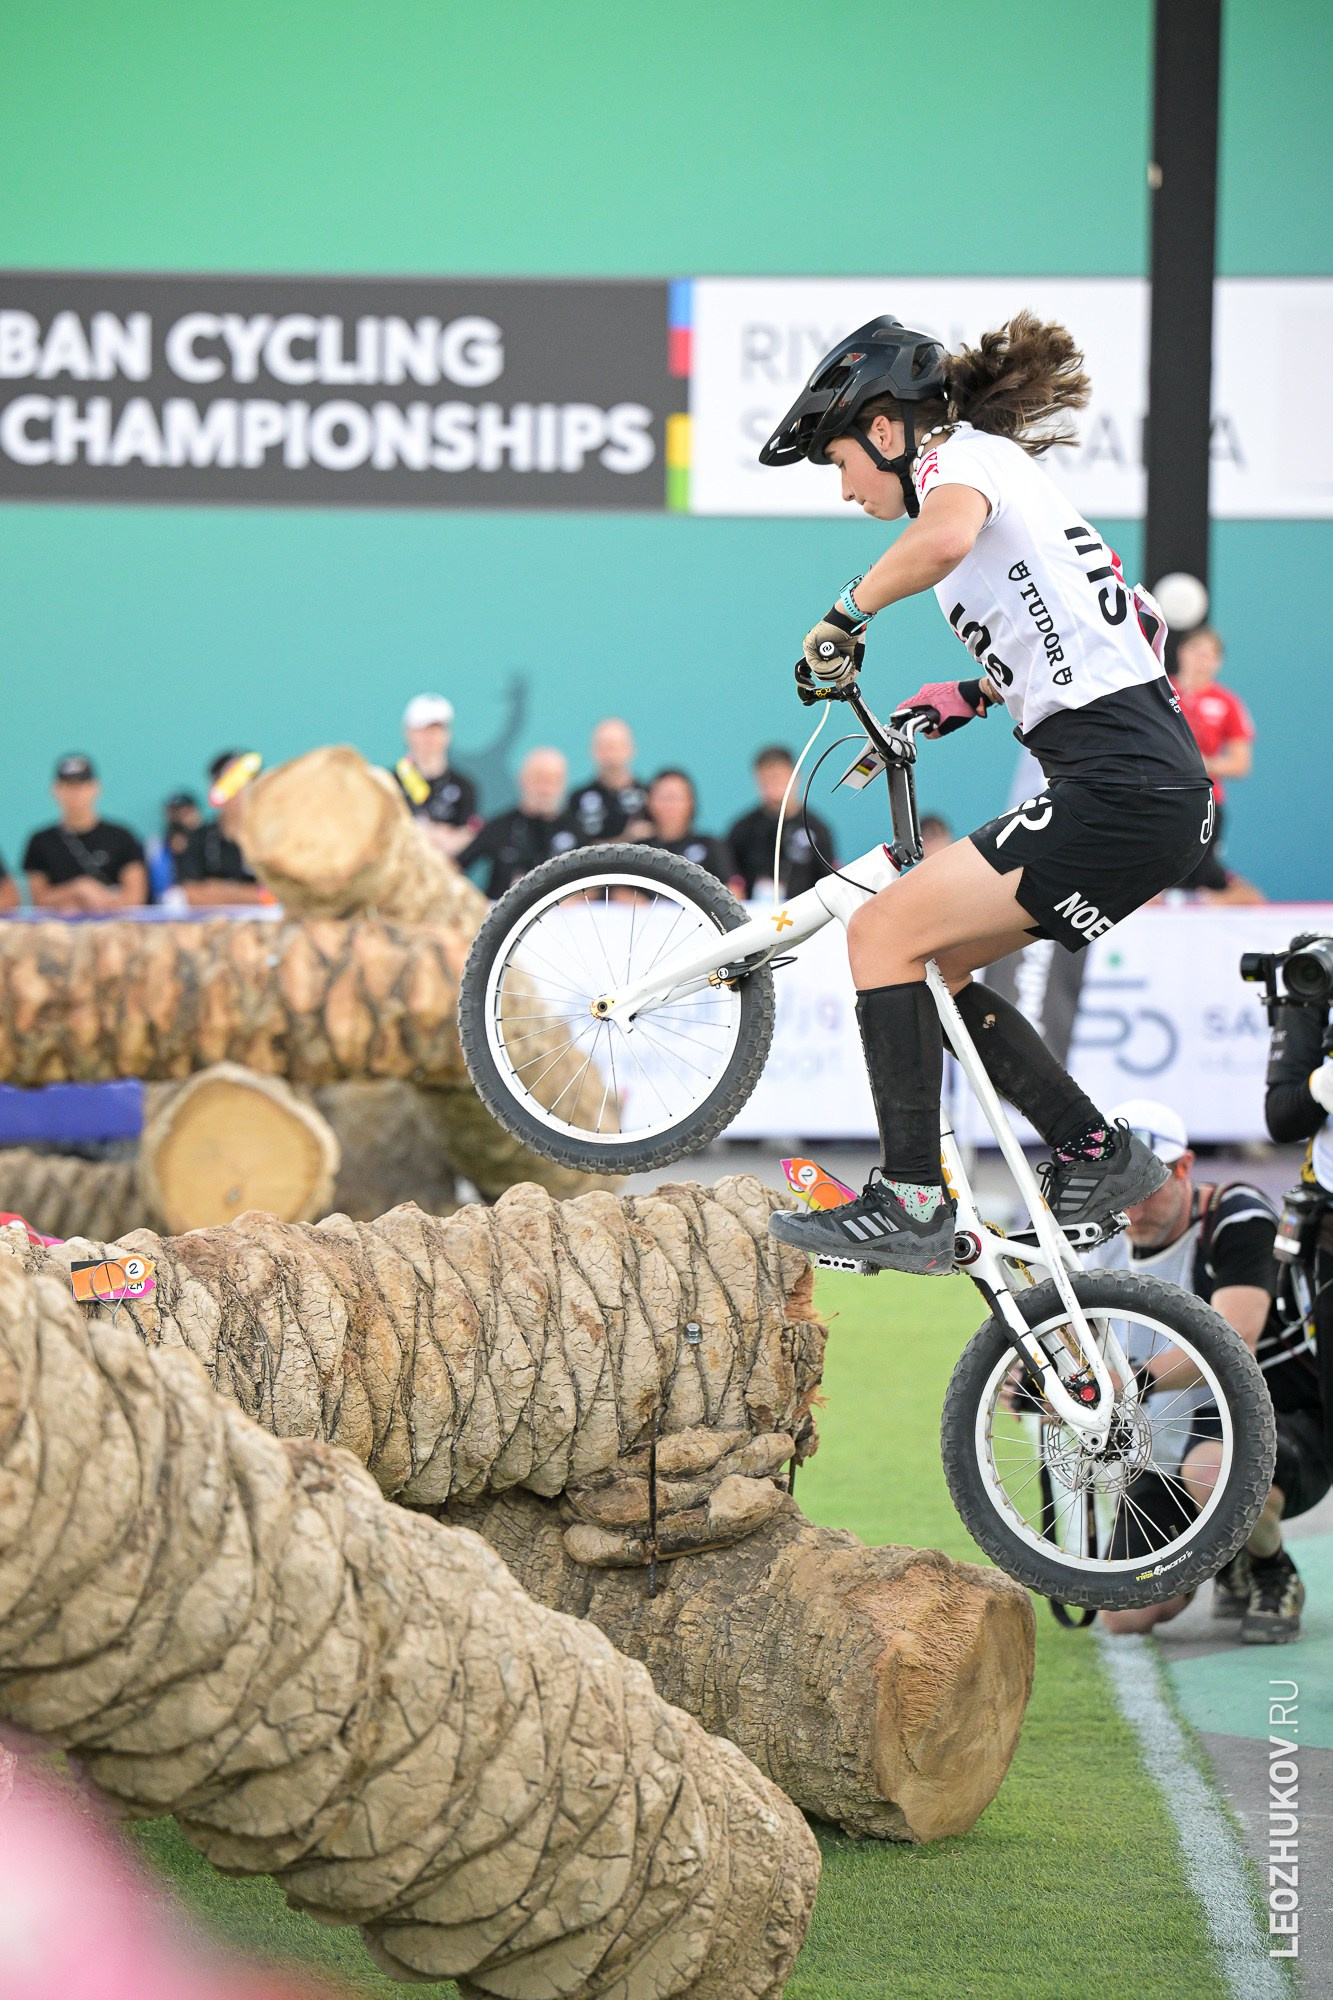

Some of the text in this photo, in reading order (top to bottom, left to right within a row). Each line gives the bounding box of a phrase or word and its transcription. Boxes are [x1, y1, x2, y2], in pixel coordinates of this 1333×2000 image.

[0, 312, 503, 386] BAN CYCLING
[2, 395, 655, 473] CHAMPIONSHIPS
[1020, 582, 1064, 666] TUDOR
[801, 1168, 814, 1182] 2
[128, 1262, 139, 1275] 2
